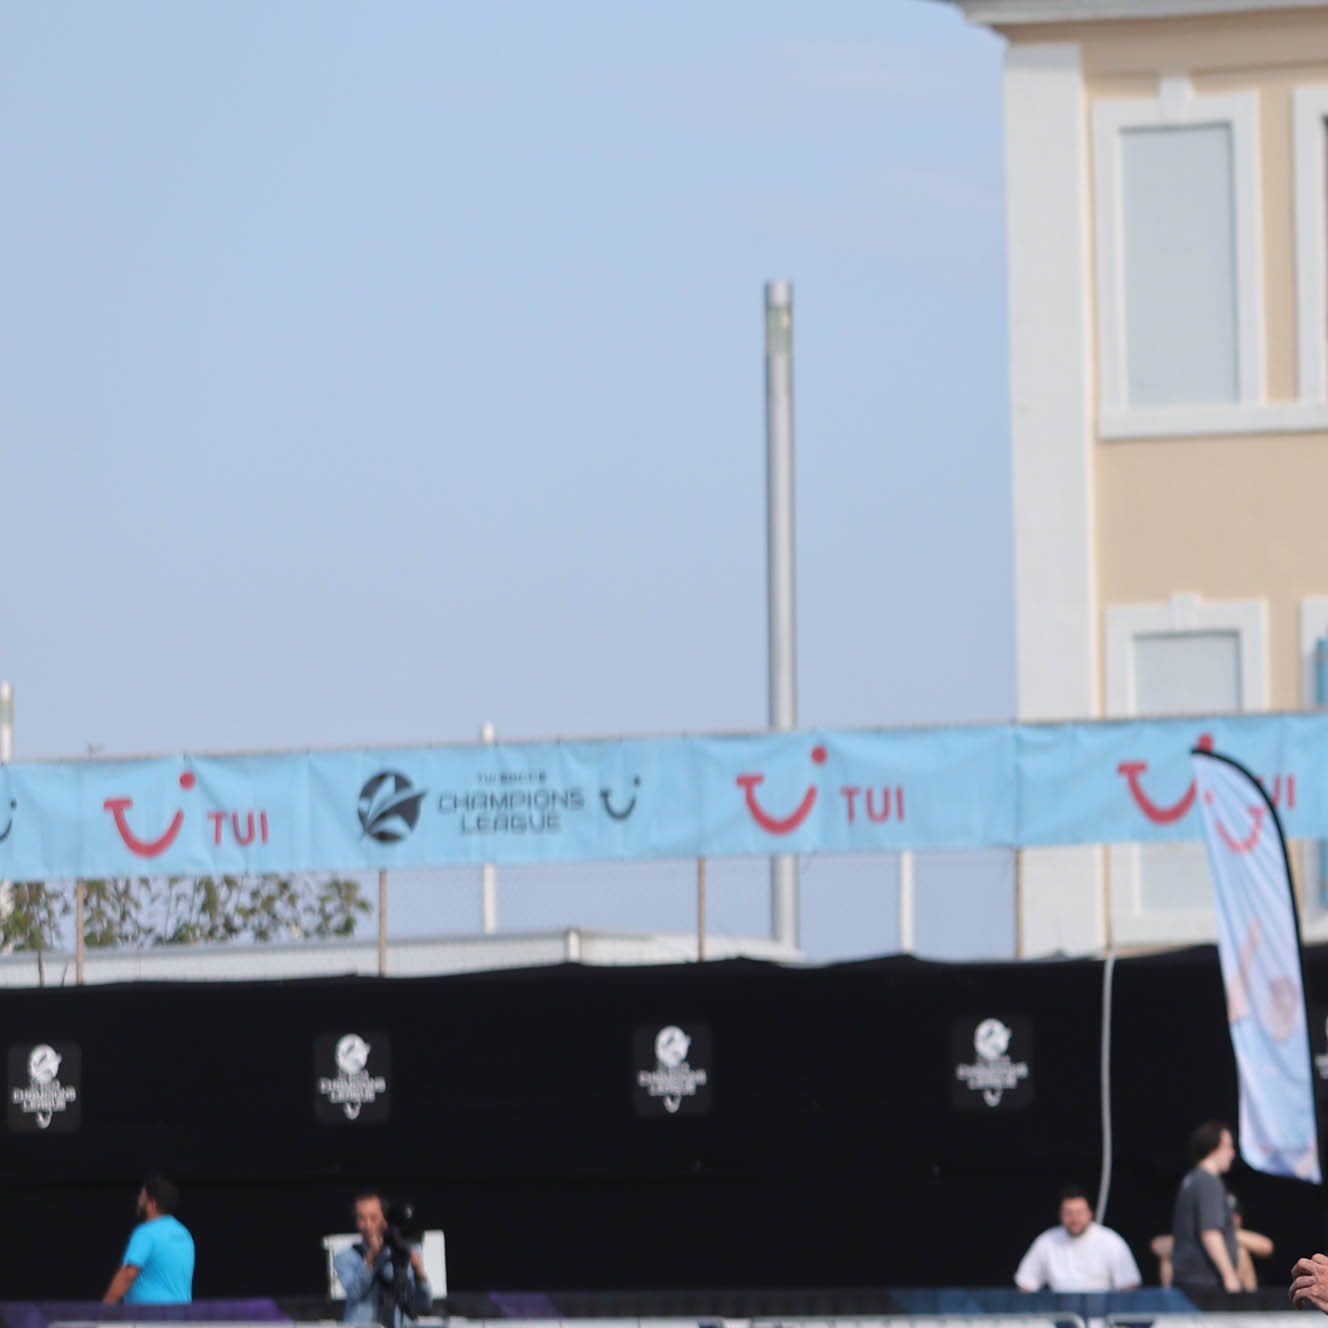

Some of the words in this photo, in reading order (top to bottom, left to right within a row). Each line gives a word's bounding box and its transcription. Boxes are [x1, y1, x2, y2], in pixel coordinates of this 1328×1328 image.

[437, 787, 585, 813] CHAMPIONS
[841, 786, 905, 823] TUI
[207, 811, 269, 846] TUI
[460, 813, 562, 835] LEAGUE
